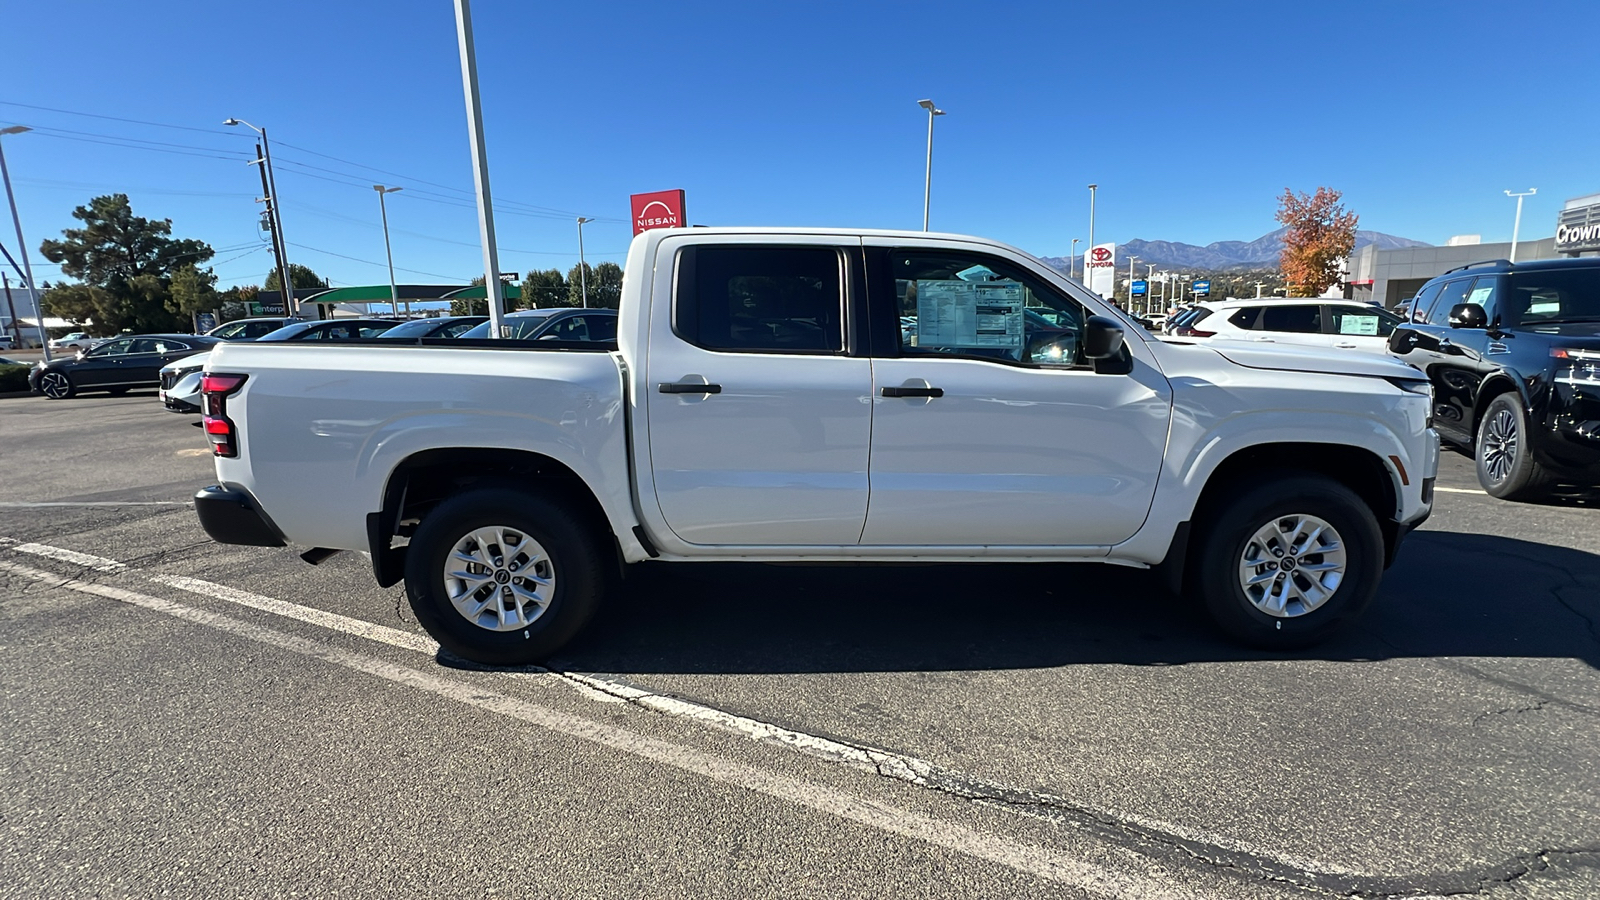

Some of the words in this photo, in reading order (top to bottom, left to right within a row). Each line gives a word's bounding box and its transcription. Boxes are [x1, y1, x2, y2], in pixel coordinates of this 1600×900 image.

[637, 216, 677, 227] NISSAN
[1556, 223, 1600, 244] Crown
[1086, 261, 1114, 269] TOYOTA
[253, 306, 284, 314] enterp
